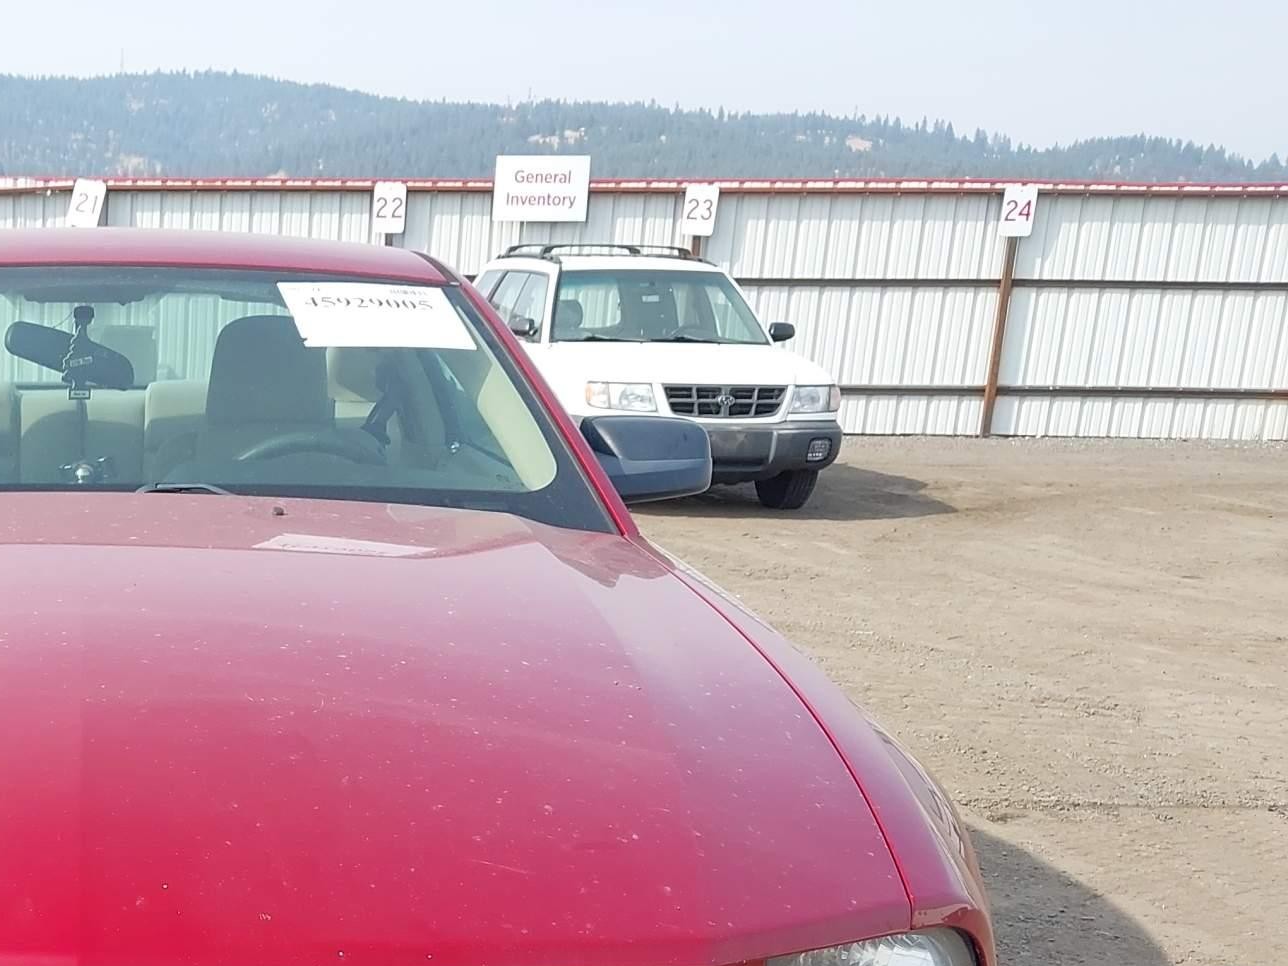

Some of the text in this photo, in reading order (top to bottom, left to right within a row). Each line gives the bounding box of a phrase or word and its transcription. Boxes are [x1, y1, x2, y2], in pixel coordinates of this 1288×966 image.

[514, 169, 572, 185] General
[75, 193, 99, 214] 21
[375, 196, 403, 218] 22
[506, 192, 577, 209] Inventory
[686, 198, 714, 220] 23
[1004, 199, 1032, 222] 24
[304, 296, 434, 310] 45929005
